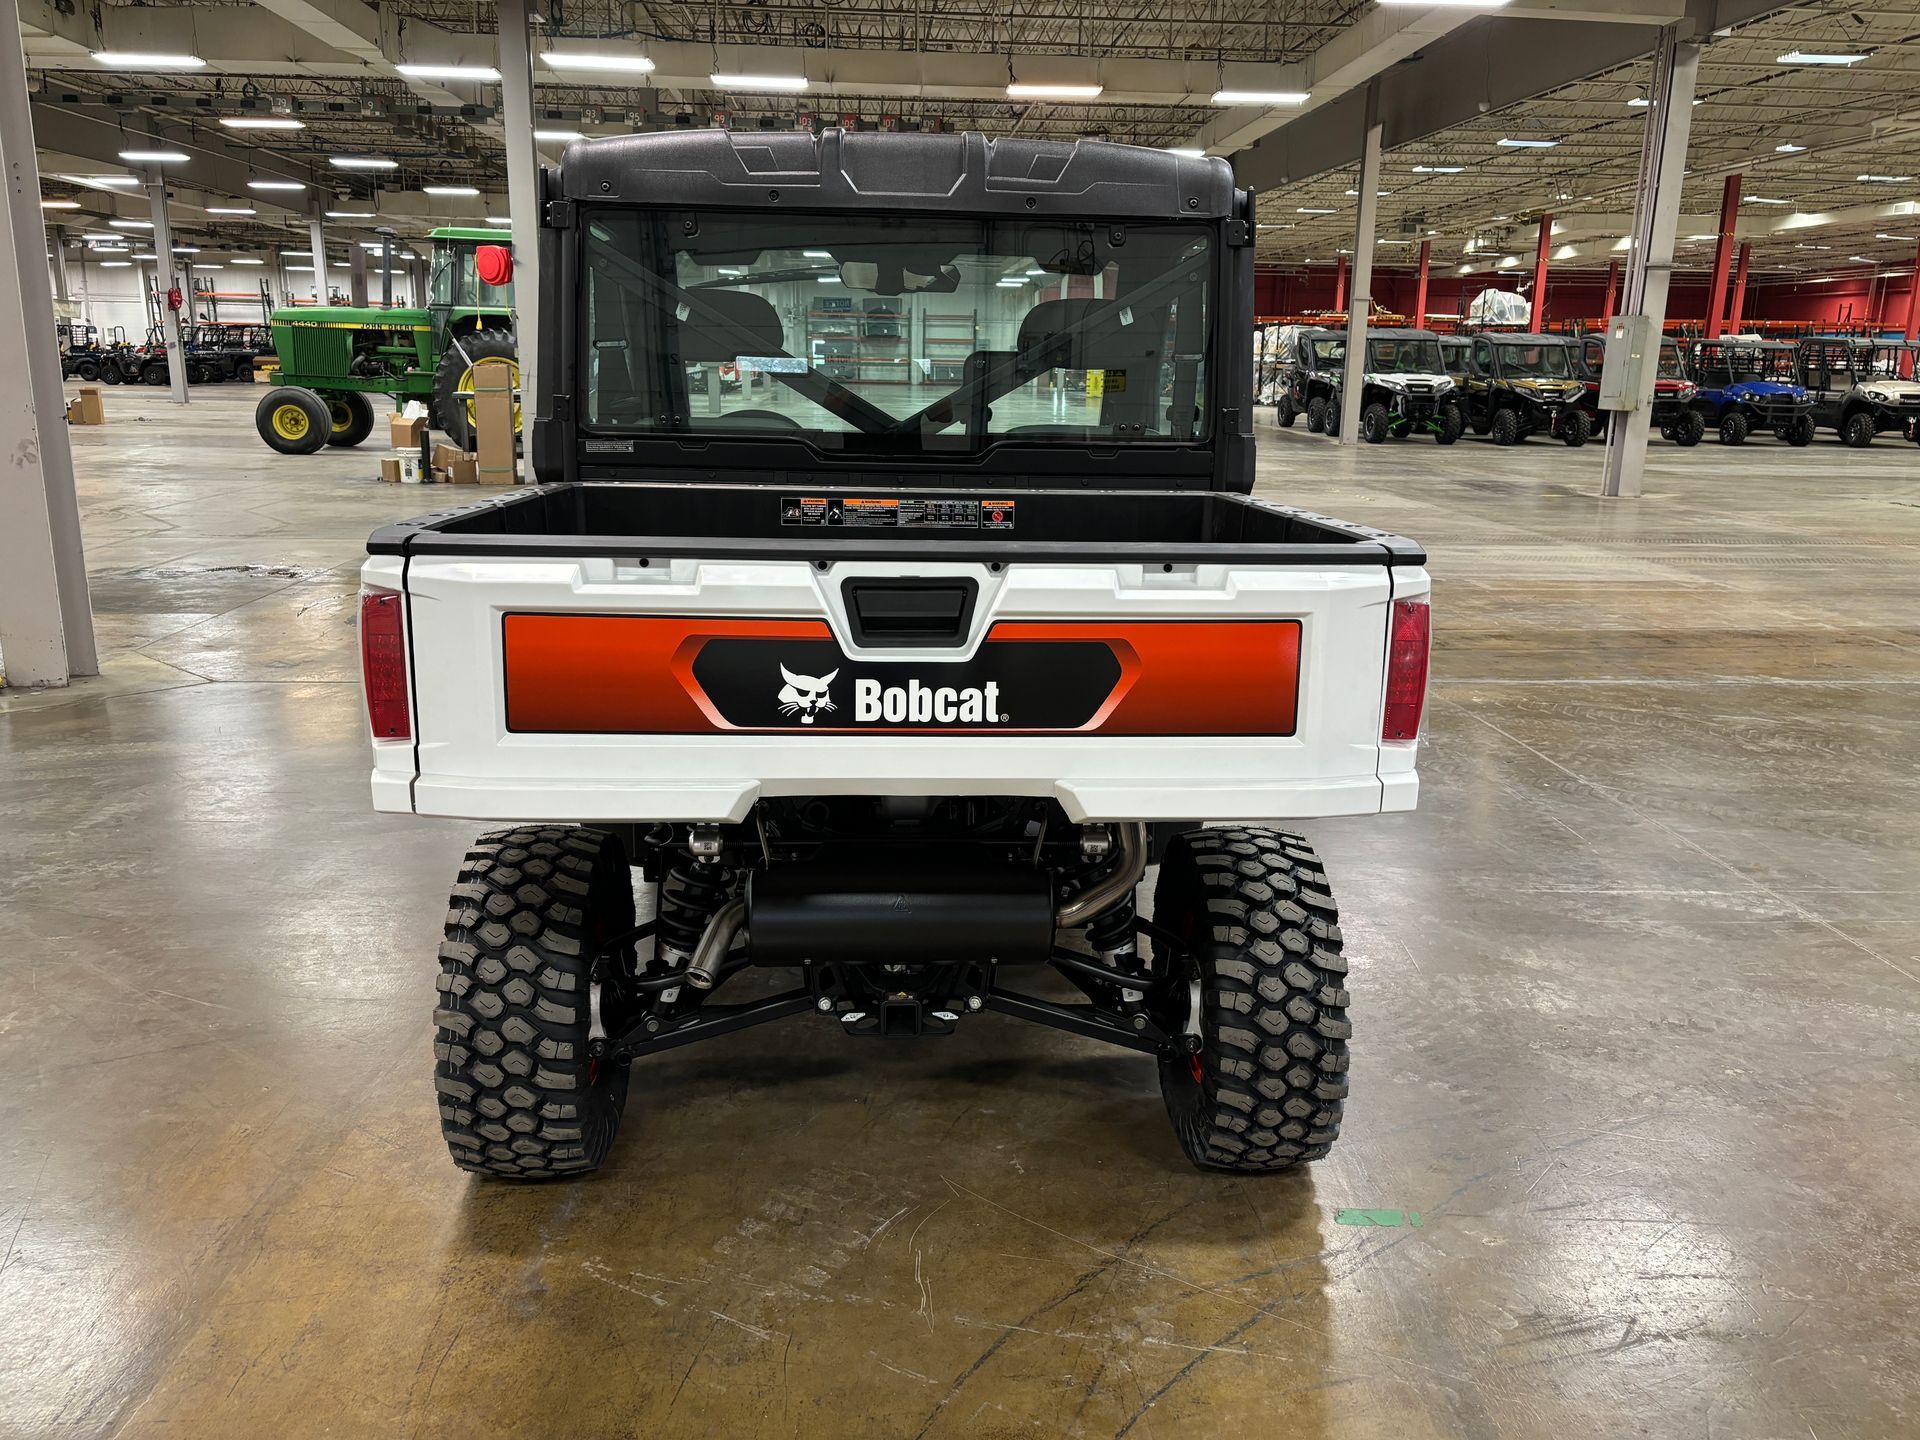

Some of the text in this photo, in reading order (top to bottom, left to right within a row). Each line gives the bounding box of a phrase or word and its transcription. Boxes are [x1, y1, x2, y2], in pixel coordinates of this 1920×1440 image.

[585, 109, 596, 118] 93
[629, 111, 640, 122] 95
[714, 114, 725, 124] 99
[292, 320, 318, 328] 4440
[855, 678, 1000, 723] Bobcat
